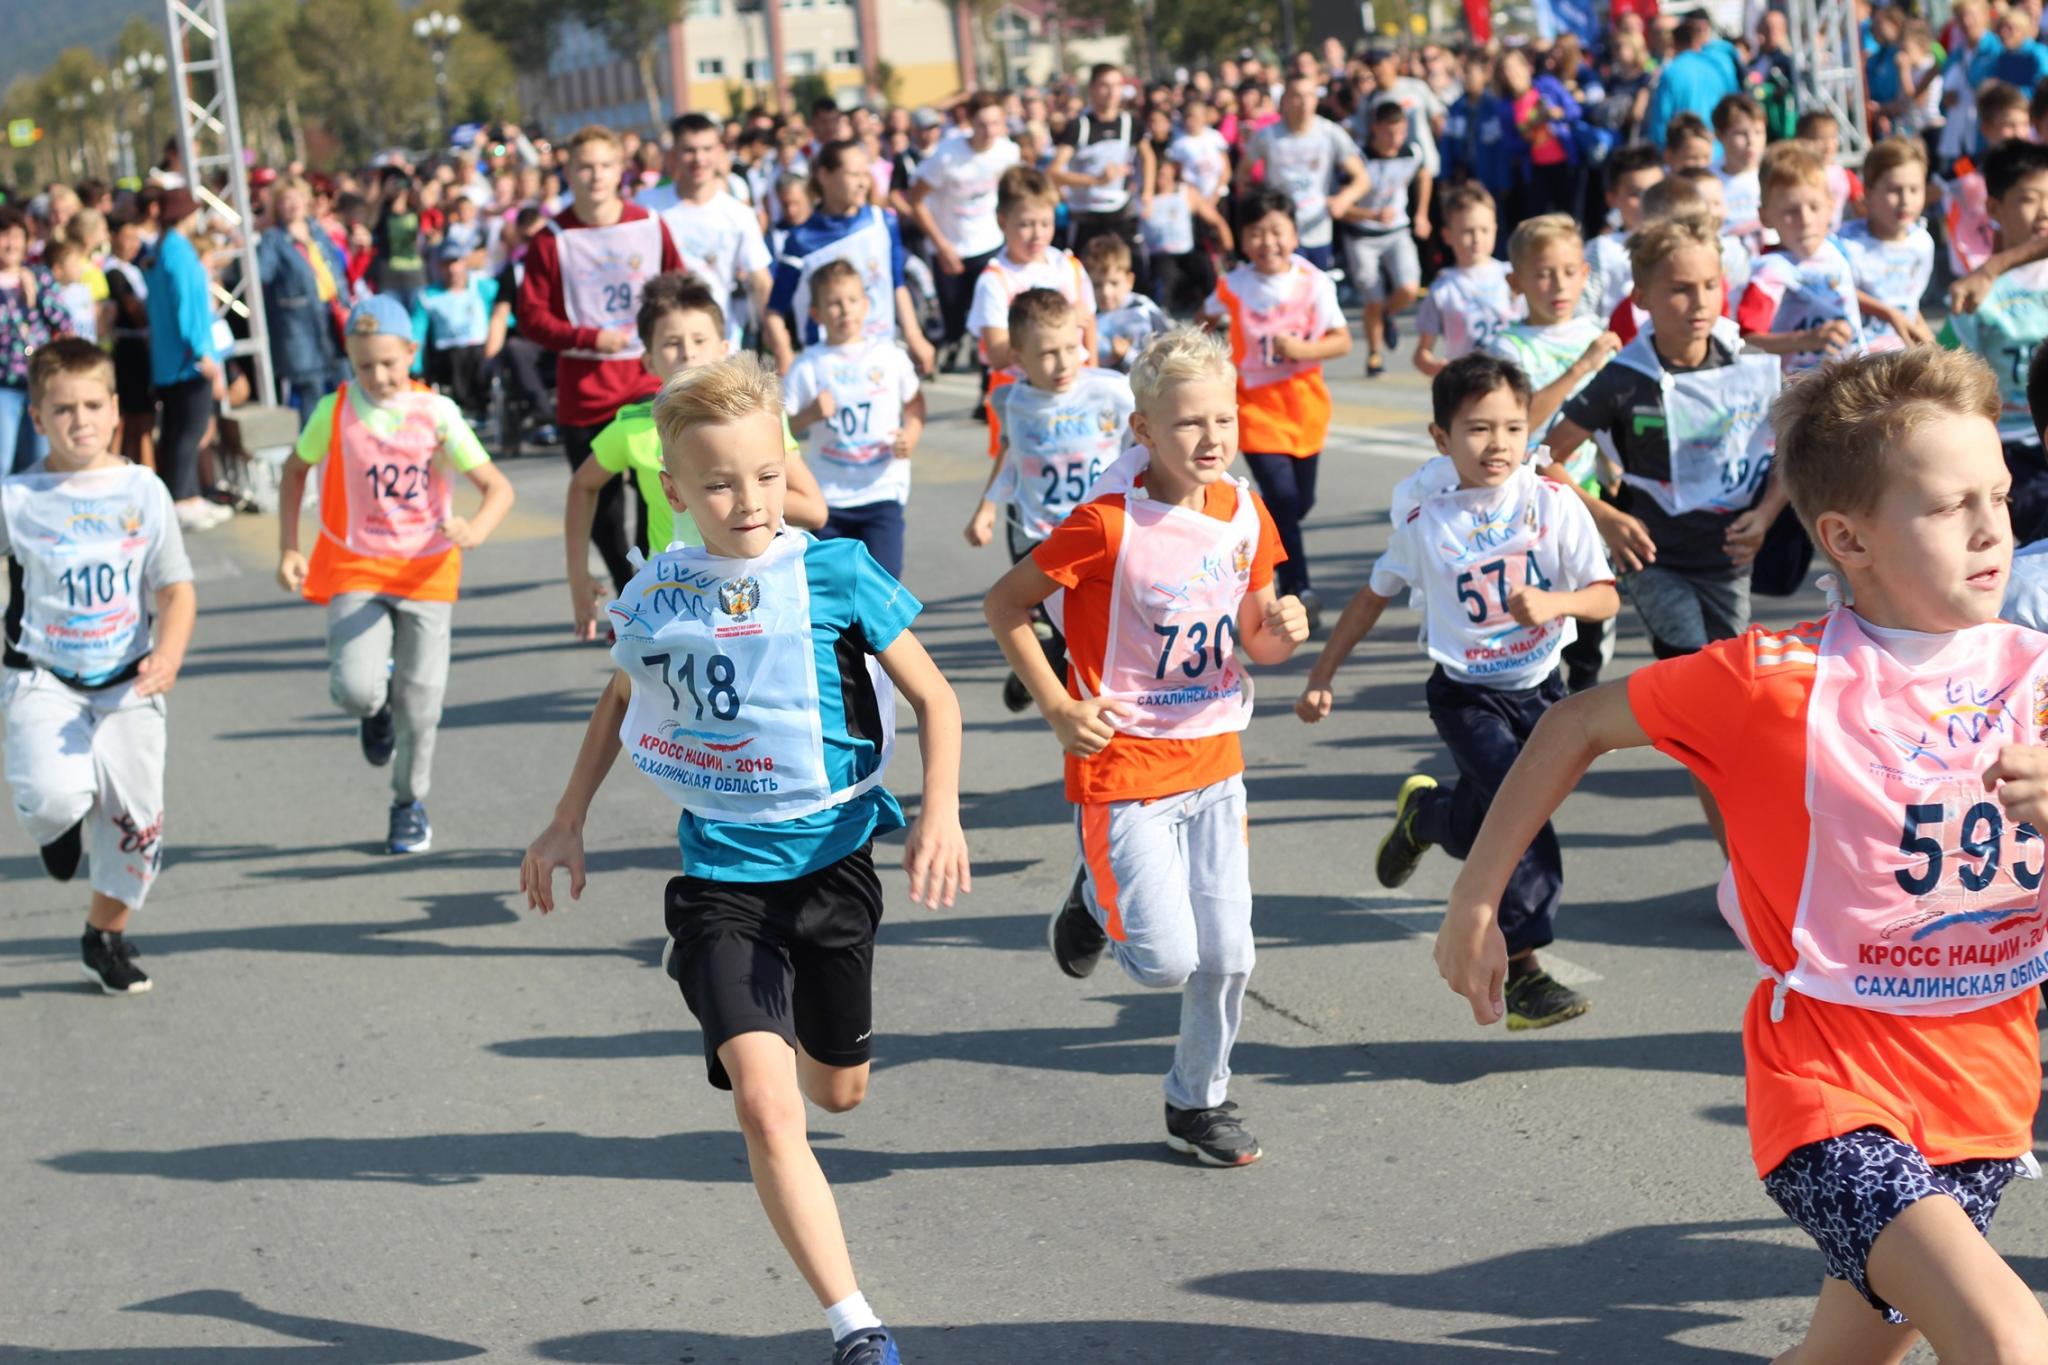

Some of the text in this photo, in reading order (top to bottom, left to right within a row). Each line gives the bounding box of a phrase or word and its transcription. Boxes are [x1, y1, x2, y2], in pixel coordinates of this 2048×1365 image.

[603, 282, 632, 312] 29
[1457, 550, 1552, 623] 574
[1154, 614, 1233, 679] 730
[641, 653, 740, 721] 718
[1137, 690, 1219, 705] САХАЛИНСКАЯ
[639, 734, 684, 760] КРОСС
[684, 748, 722, 771] НАЦИИ
[735, 757, 774, 772] 2018
[632, 753, 778, 793] САХАЛИНСКАЯ ОБЛАСТЬ
[1894, 802, 2045, 896] 595
[1859, 944, 1940, 967] КРОСС
[1949, 936, 2020, 967] НАЦИИ
[1855, 973, 2006, 998] САХАЛИНСКАЯ
